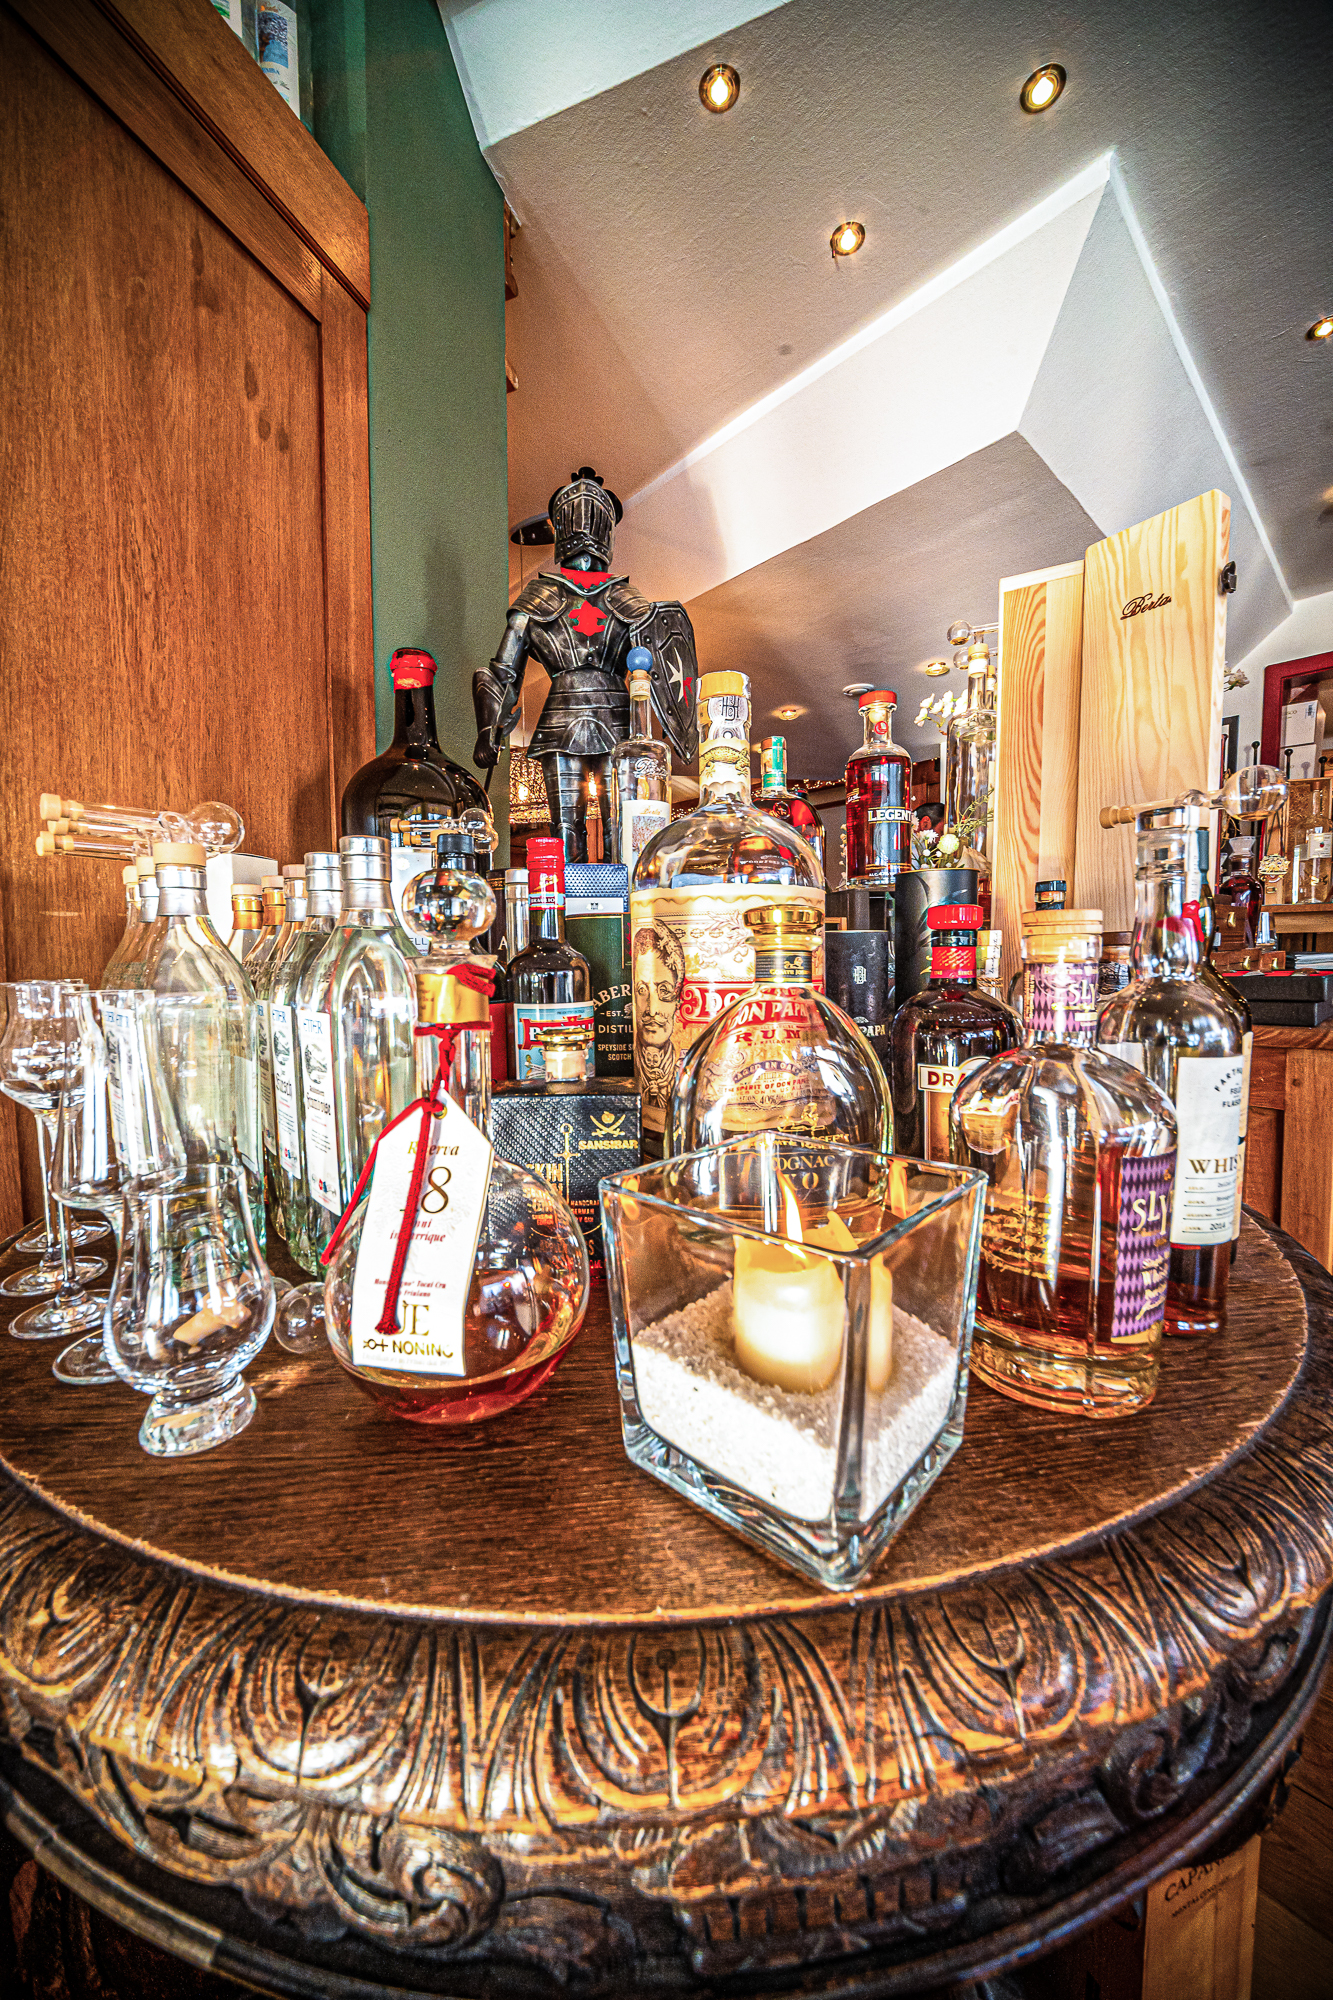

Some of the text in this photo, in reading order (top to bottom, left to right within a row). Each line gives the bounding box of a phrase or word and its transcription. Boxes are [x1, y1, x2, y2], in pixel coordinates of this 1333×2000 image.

[1120, 593, 1172, 620] Berta
[868, 809, 912, 822] LEGENT
[734, 1029, 802, 1044] RUM
[597, 1043, 626, 1052] SPEYSIDE
[607, 1053, 632, 1061] SCOTCH
[407, 1140, 460, 1157] Rerva
[578, 1139, 638, 1151] SANSIBAR
[771, 1154, 836, 1172] COGNAC
[415, 1218, 433, 1229] nni
[404, 1290, 432, 1298] Friulano
